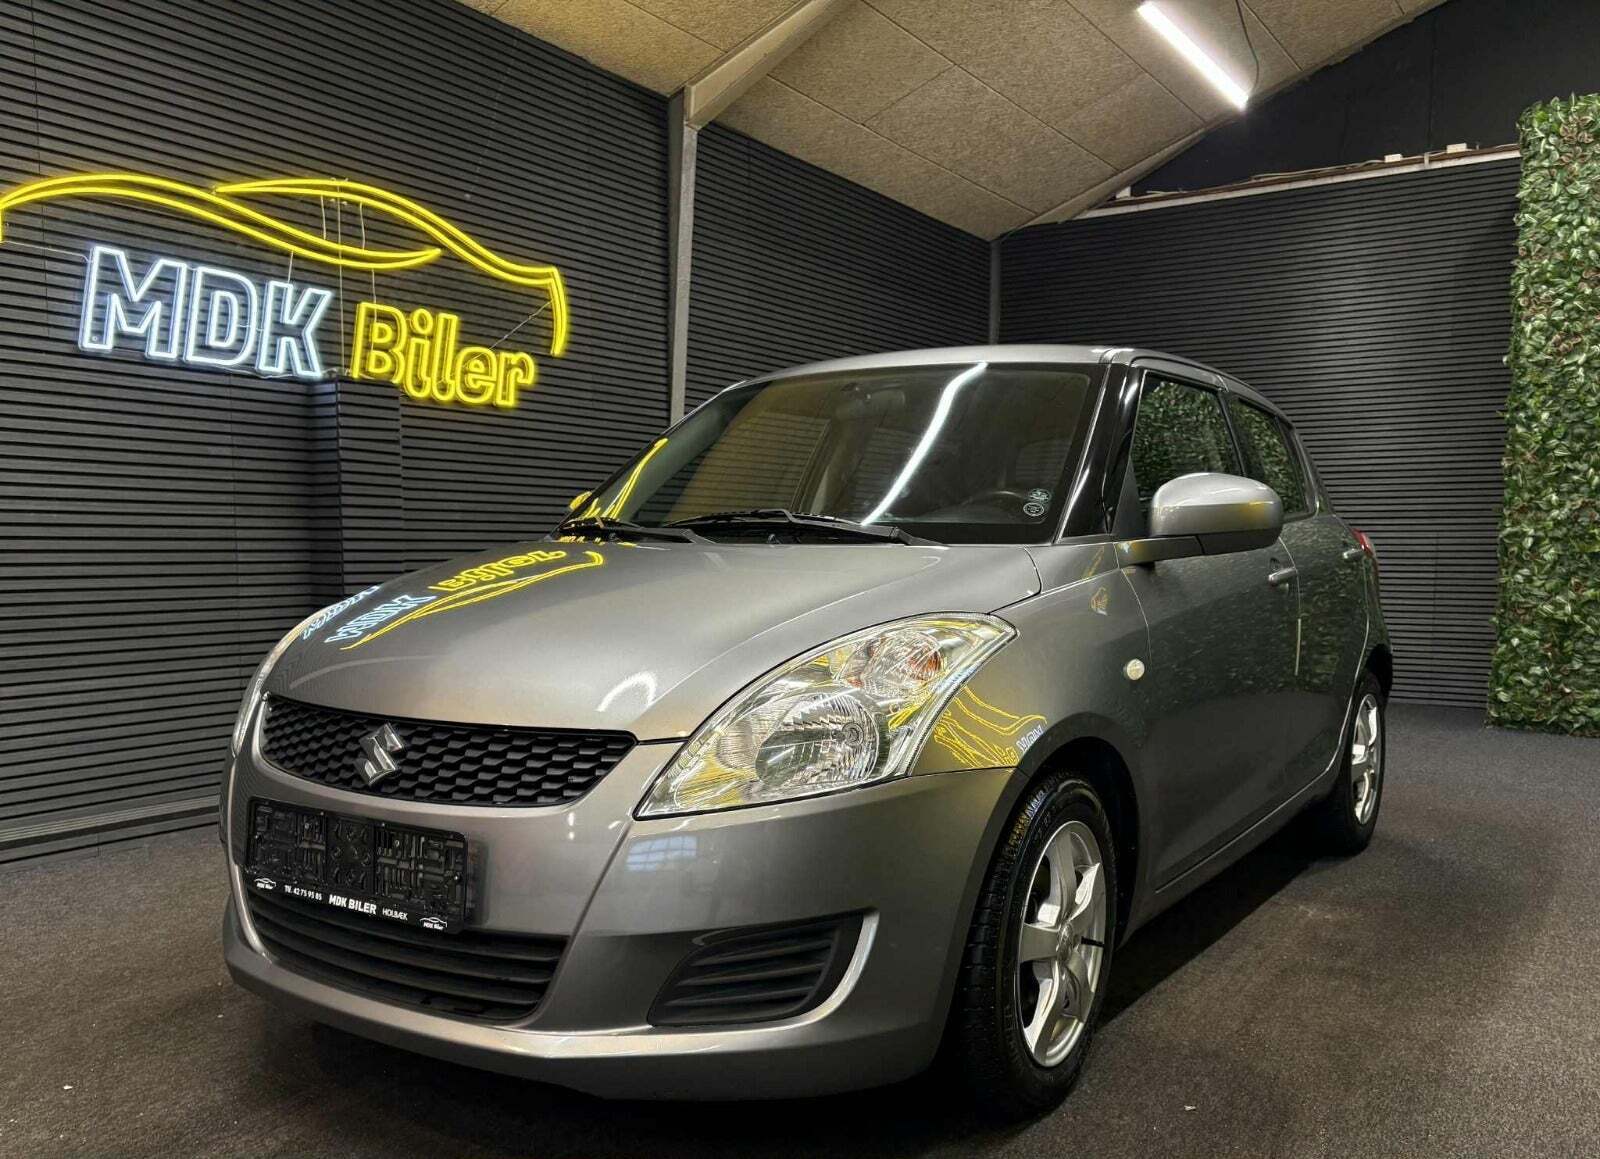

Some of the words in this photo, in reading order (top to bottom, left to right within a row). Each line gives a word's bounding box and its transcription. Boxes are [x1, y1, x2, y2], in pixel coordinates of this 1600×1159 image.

[78, 245, 333, 379] MDK
[350, 301, 536, 407] Biler
[329, 894, 347, 908] MDK
[348, 898, 377, 915] BILER
